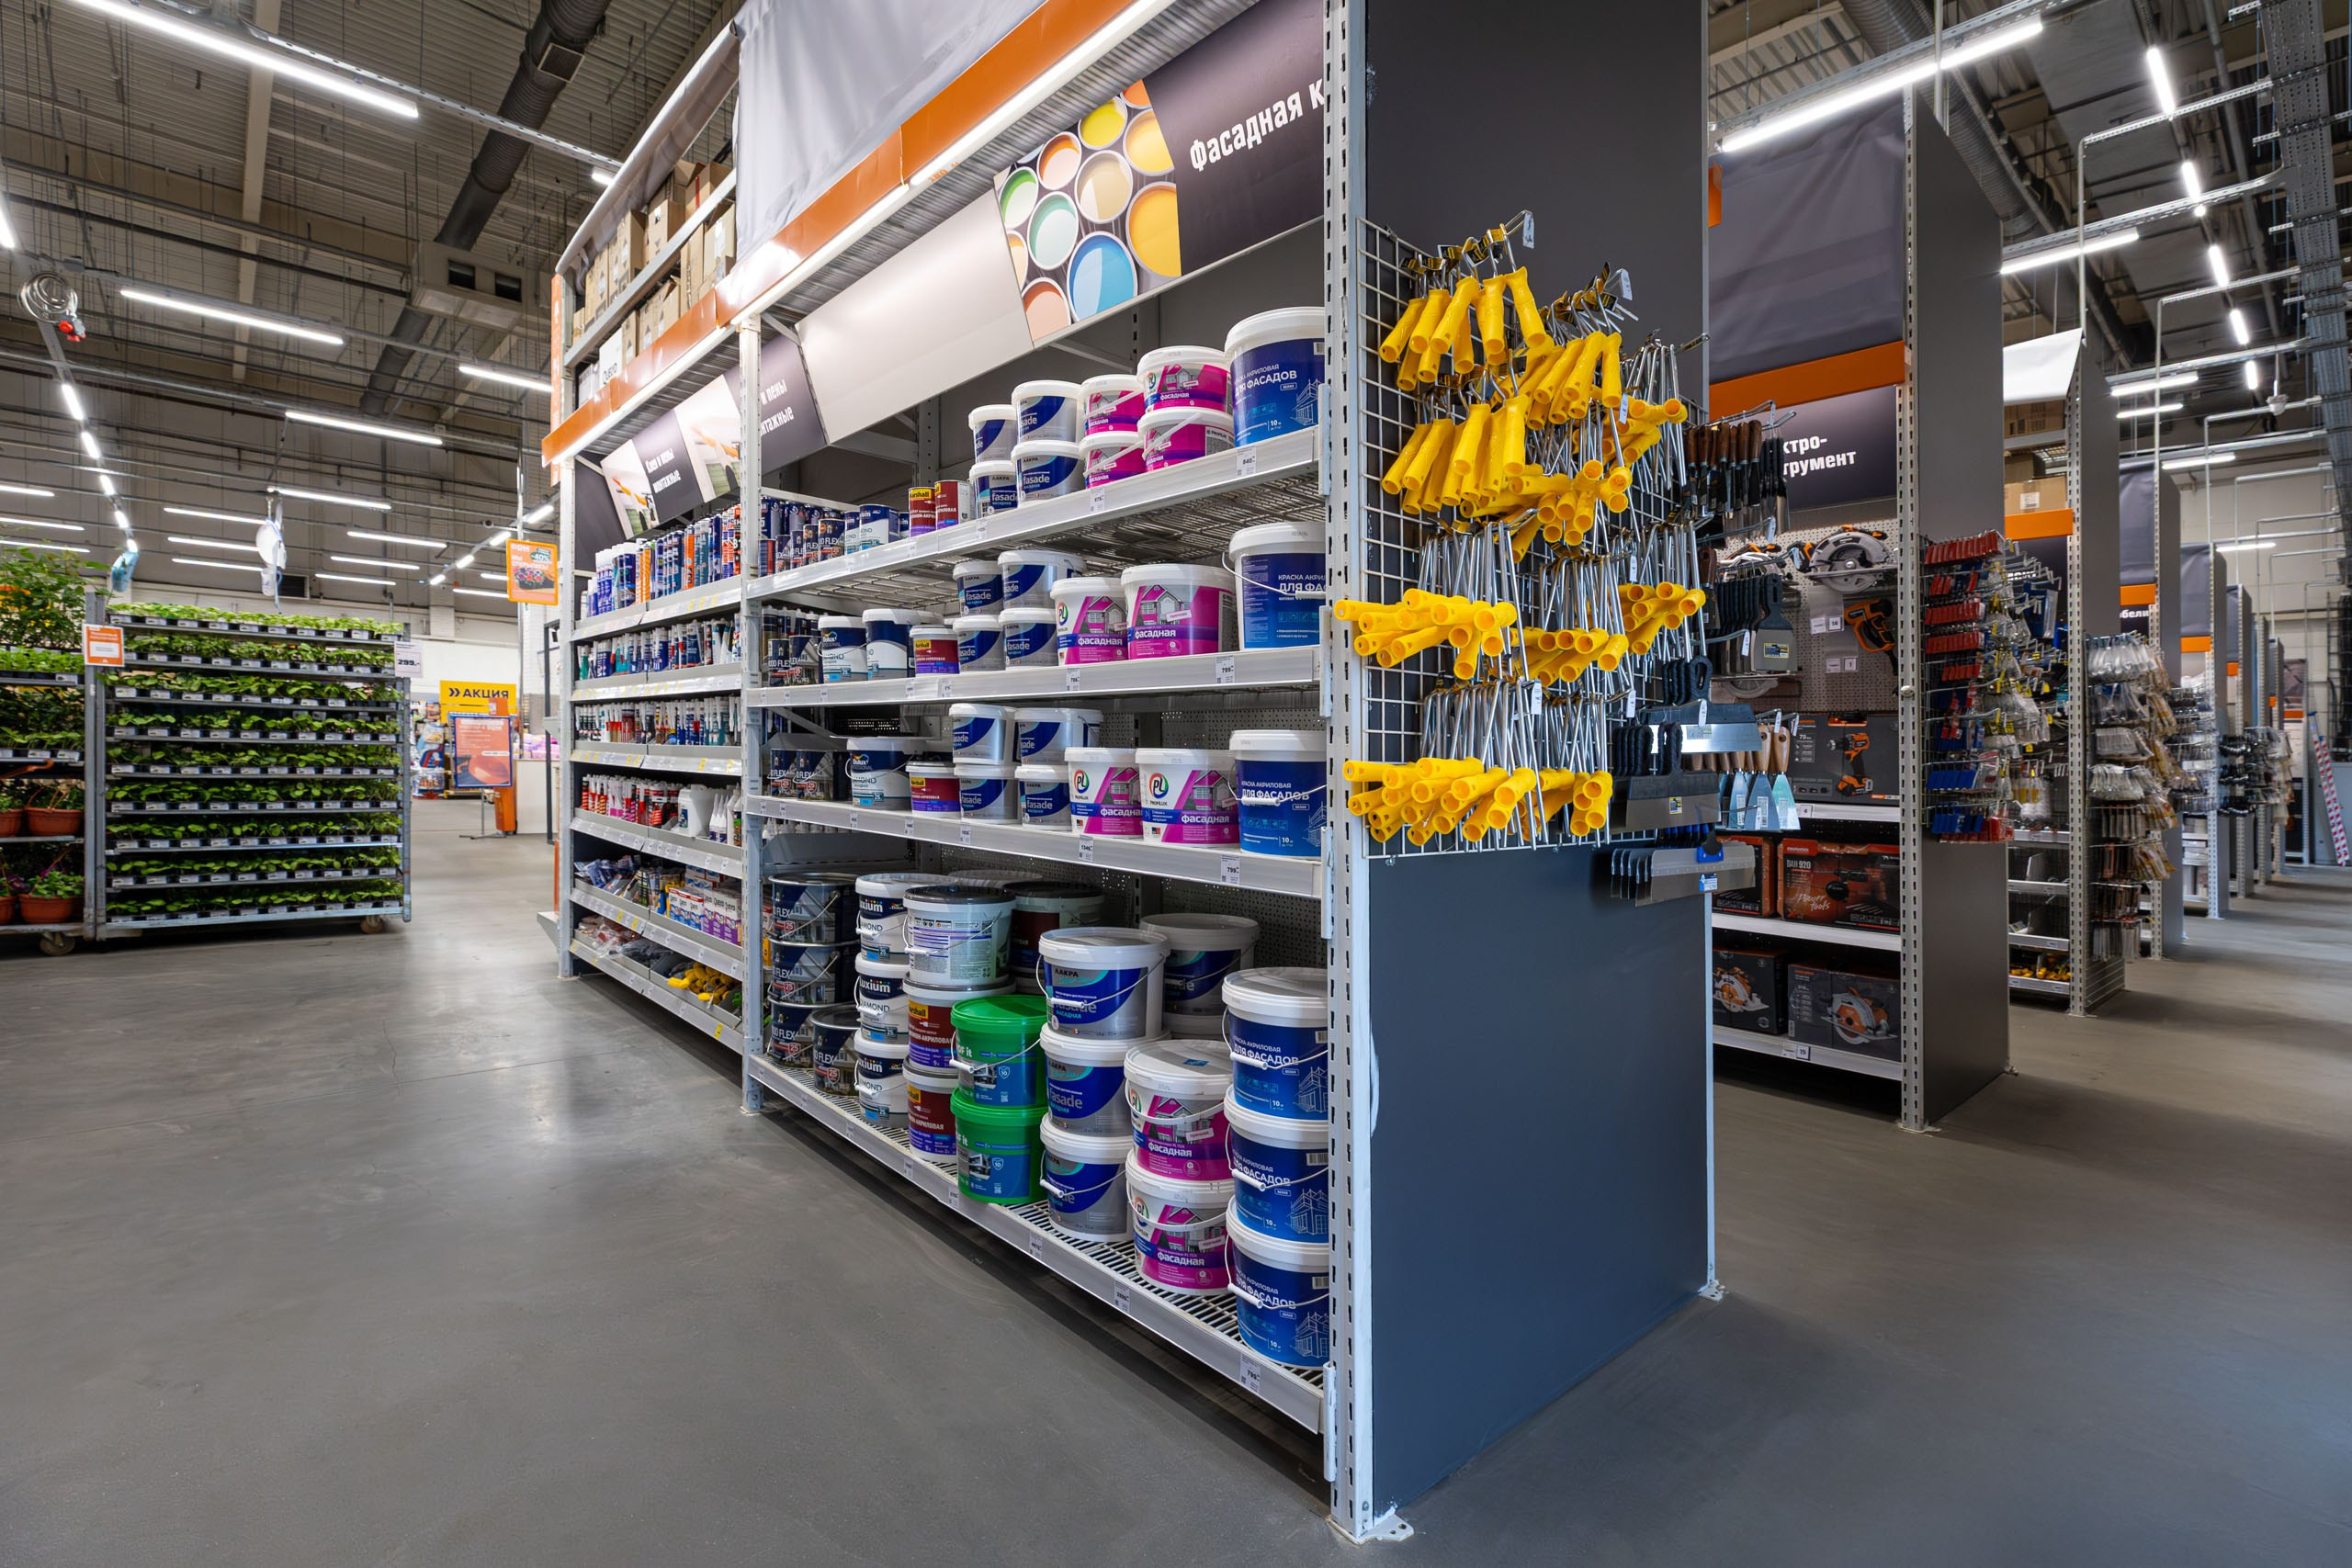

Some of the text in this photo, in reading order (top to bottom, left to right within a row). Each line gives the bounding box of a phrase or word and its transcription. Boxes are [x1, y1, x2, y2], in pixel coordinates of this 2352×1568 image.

[1190, 91, 1303, 172] Фасадная
[1246, 363, 1280, 378] АКРИЛОВАЯ
[1247, 369, 1297, 389] ФАСАДОВ
[765, 378, 787, 402] пены
[1159, 390, 1190, 401] фасадная
[760, 406, 795, 436] нтажные
[1020, 416, 1038, 427] sade
[1783, 435, 1827, 455] ктро-
[1783, 451, 1857, 478] трумент
[1023, 474, 1050, 485] fasade
[910, 491, 930, 499] arshall
[1279, 582, 1303, 593] ДЛЯ
[966, 592, 992, 600] fasade
[2120, 609, 2149, 619] бели
[1134, 628, 1177, 639] фасадная
[1007, 641, 1030, 650] fasade
[1077, 637, 1123, 648] фасадная
[462, 688, 509, 699] АКЦИЯ
[1256, 790, 1310, 801] ФАСАДОВ
[1026, 799, 1053, 809] fasade
[1181, 814, 1229, 824] фасадная
[1786, 859, 1812, 870] DAH 920
[1797, 892, 1826, 904] Power
[1810, 901, 1831, 912] tools
[776, 907, 791, 919] FLEX
[775, 967, 791, 979] FLEX
[778, 1028, 796, 1041] FLEX
[1247, 1041, 1282, 1054] АКРИЛОВАЯ
[818, 1052, 834, 1065] FLEX
[1247, 1048, 1300, 1066] ФАСАДОВ
[829, 1069, 838, 1077] 25
[1050, 1088, 1083, 1110] fasade
[1148, 1141, 1193, 1157] фасадная
[1243, 1167, 1292, 1187] ФАСАДОВ
[1157, 1251, 1205, 1267] фасадная
[1245, 1286, 1297, 1310] ФАСАДОВ
